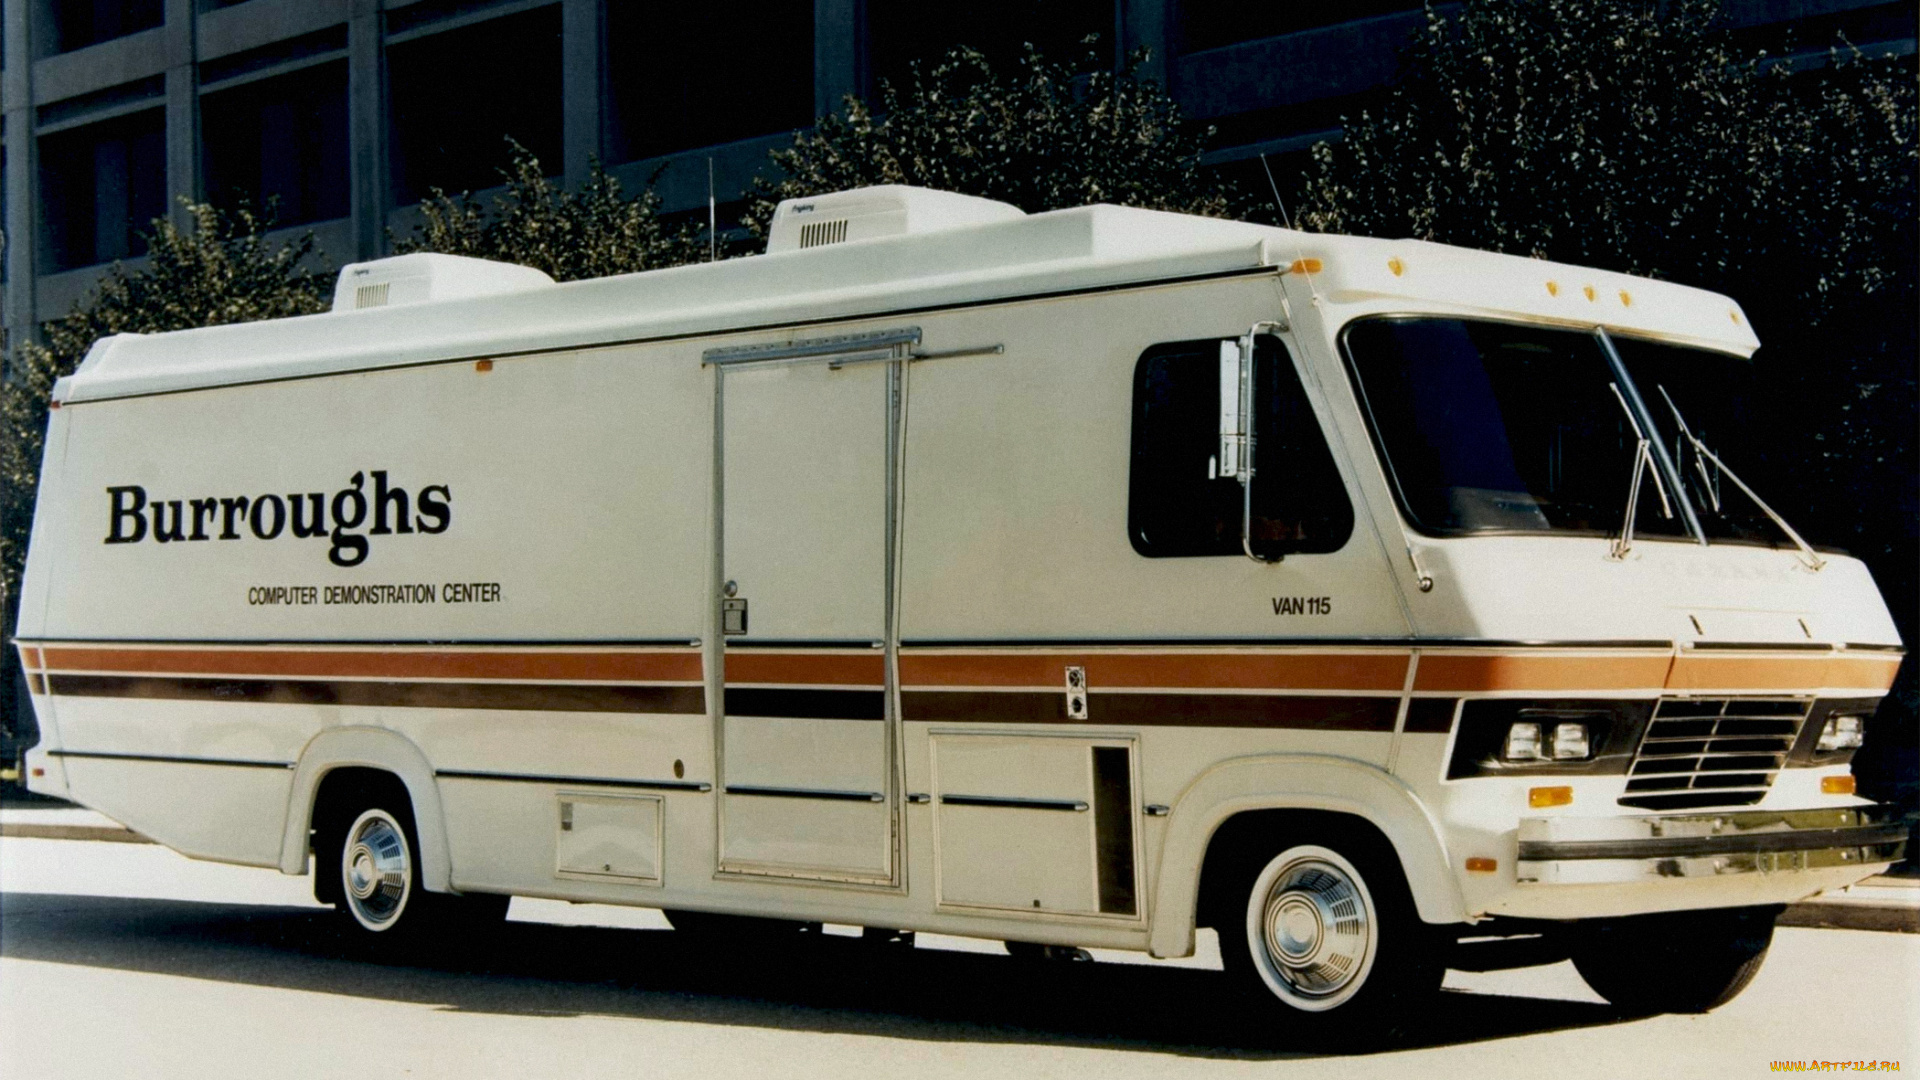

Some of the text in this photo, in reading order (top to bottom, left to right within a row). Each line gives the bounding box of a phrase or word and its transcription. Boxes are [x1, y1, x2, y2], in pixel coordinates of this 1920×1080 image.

[104, 470, 452, 567] Burroughs
[248, 582, 501, 605] COMPUTER DEMONSTRATION CENTER
[1272, 596, 1331, 615] VAN 115
